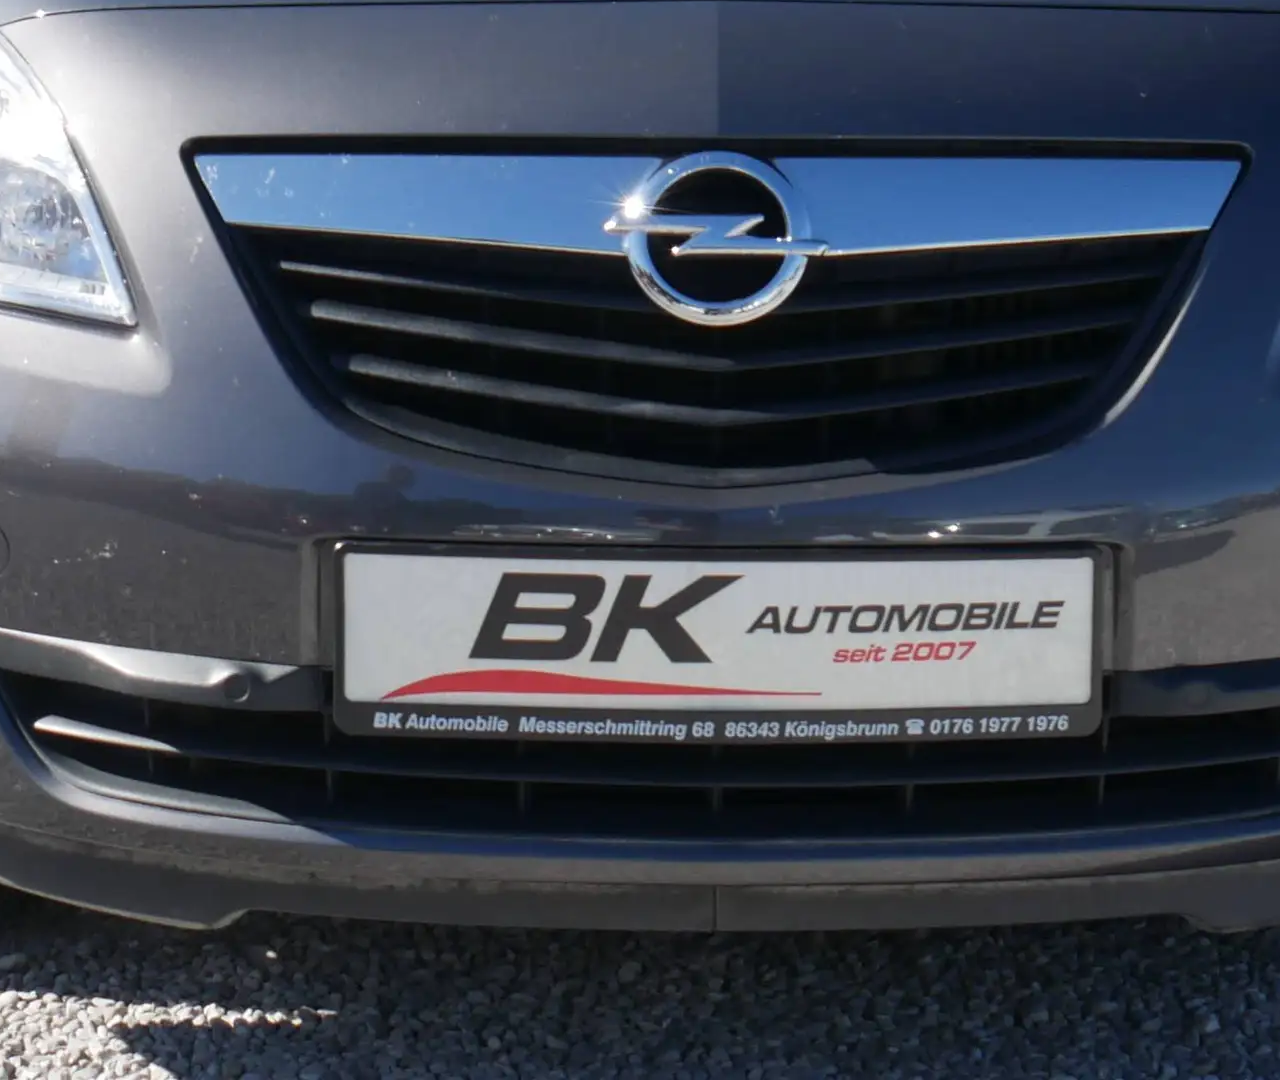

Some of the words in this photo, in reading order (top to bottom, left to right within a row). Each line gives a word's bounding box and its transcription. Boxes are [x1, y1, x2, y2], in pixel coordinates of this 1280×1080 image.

[468, 572, 744, 664] BK
[745, 600, 1065, 635] AUTOMOBILE
[832, 643, 887, 664] seit
[890, 640, 978, 663] 2007
[373, 712, 403, 729] BK
[405, 713, 510, 732] Automobile
[518, 716, 688, 740] Messerschmittring
[691, 721, 716, 737] 68
[724, 721, 781, 738] 86343
[784, 721, 900, 741] Königsbrunn
[929, 718, 975, 735] 0176
[978, 717, 1022, 733] 1977
[1026, 715, 1070, 732] 1976
